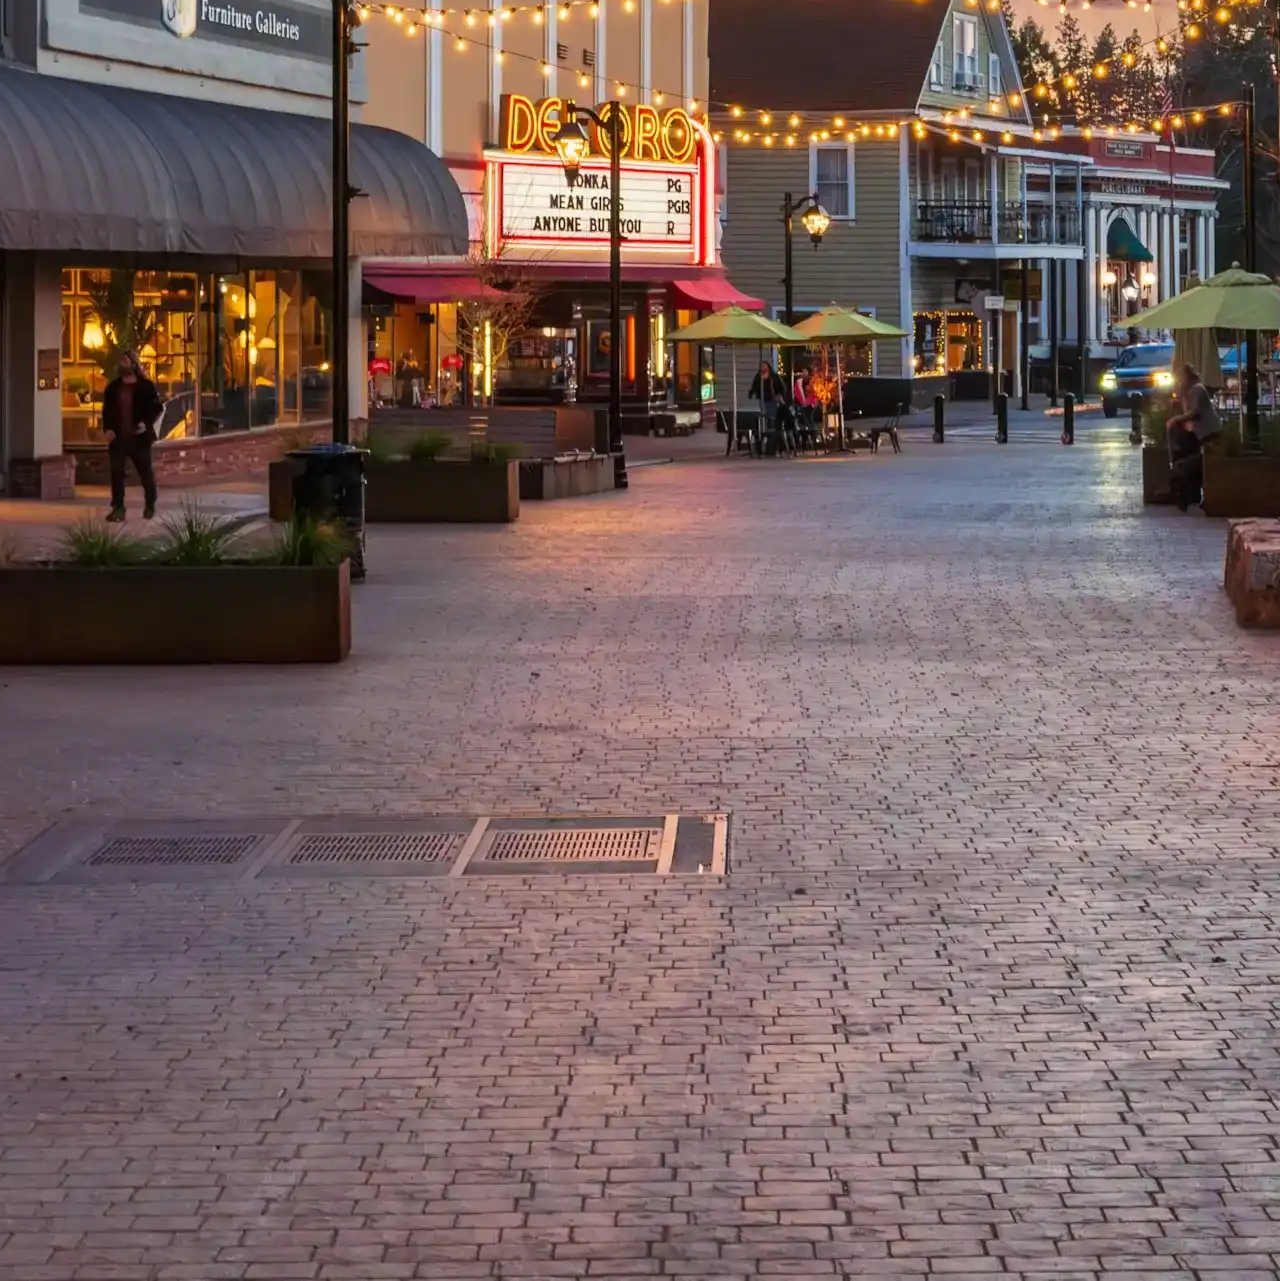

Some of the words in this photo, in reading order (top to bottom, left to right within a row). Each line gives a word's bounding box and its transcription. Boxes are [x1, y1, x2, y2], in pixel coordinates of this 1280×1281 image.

[255, 10, 300, 41] Galleries
[501, 94, 586, 155] DE
[595, 100, 696, 164] ORO
[566, 173, 609, 190] ONKA
[667, 178, 682, 193] PG
[549, 194, 584, 210] MEAN
[590, 196, 624, 211] GIRS
[667, 199, 691, 214] PG13
[533, 216, 582, 232] ANYONE
[618, 218, 641, 234] YOU
[667, 220, 675, 235] R
